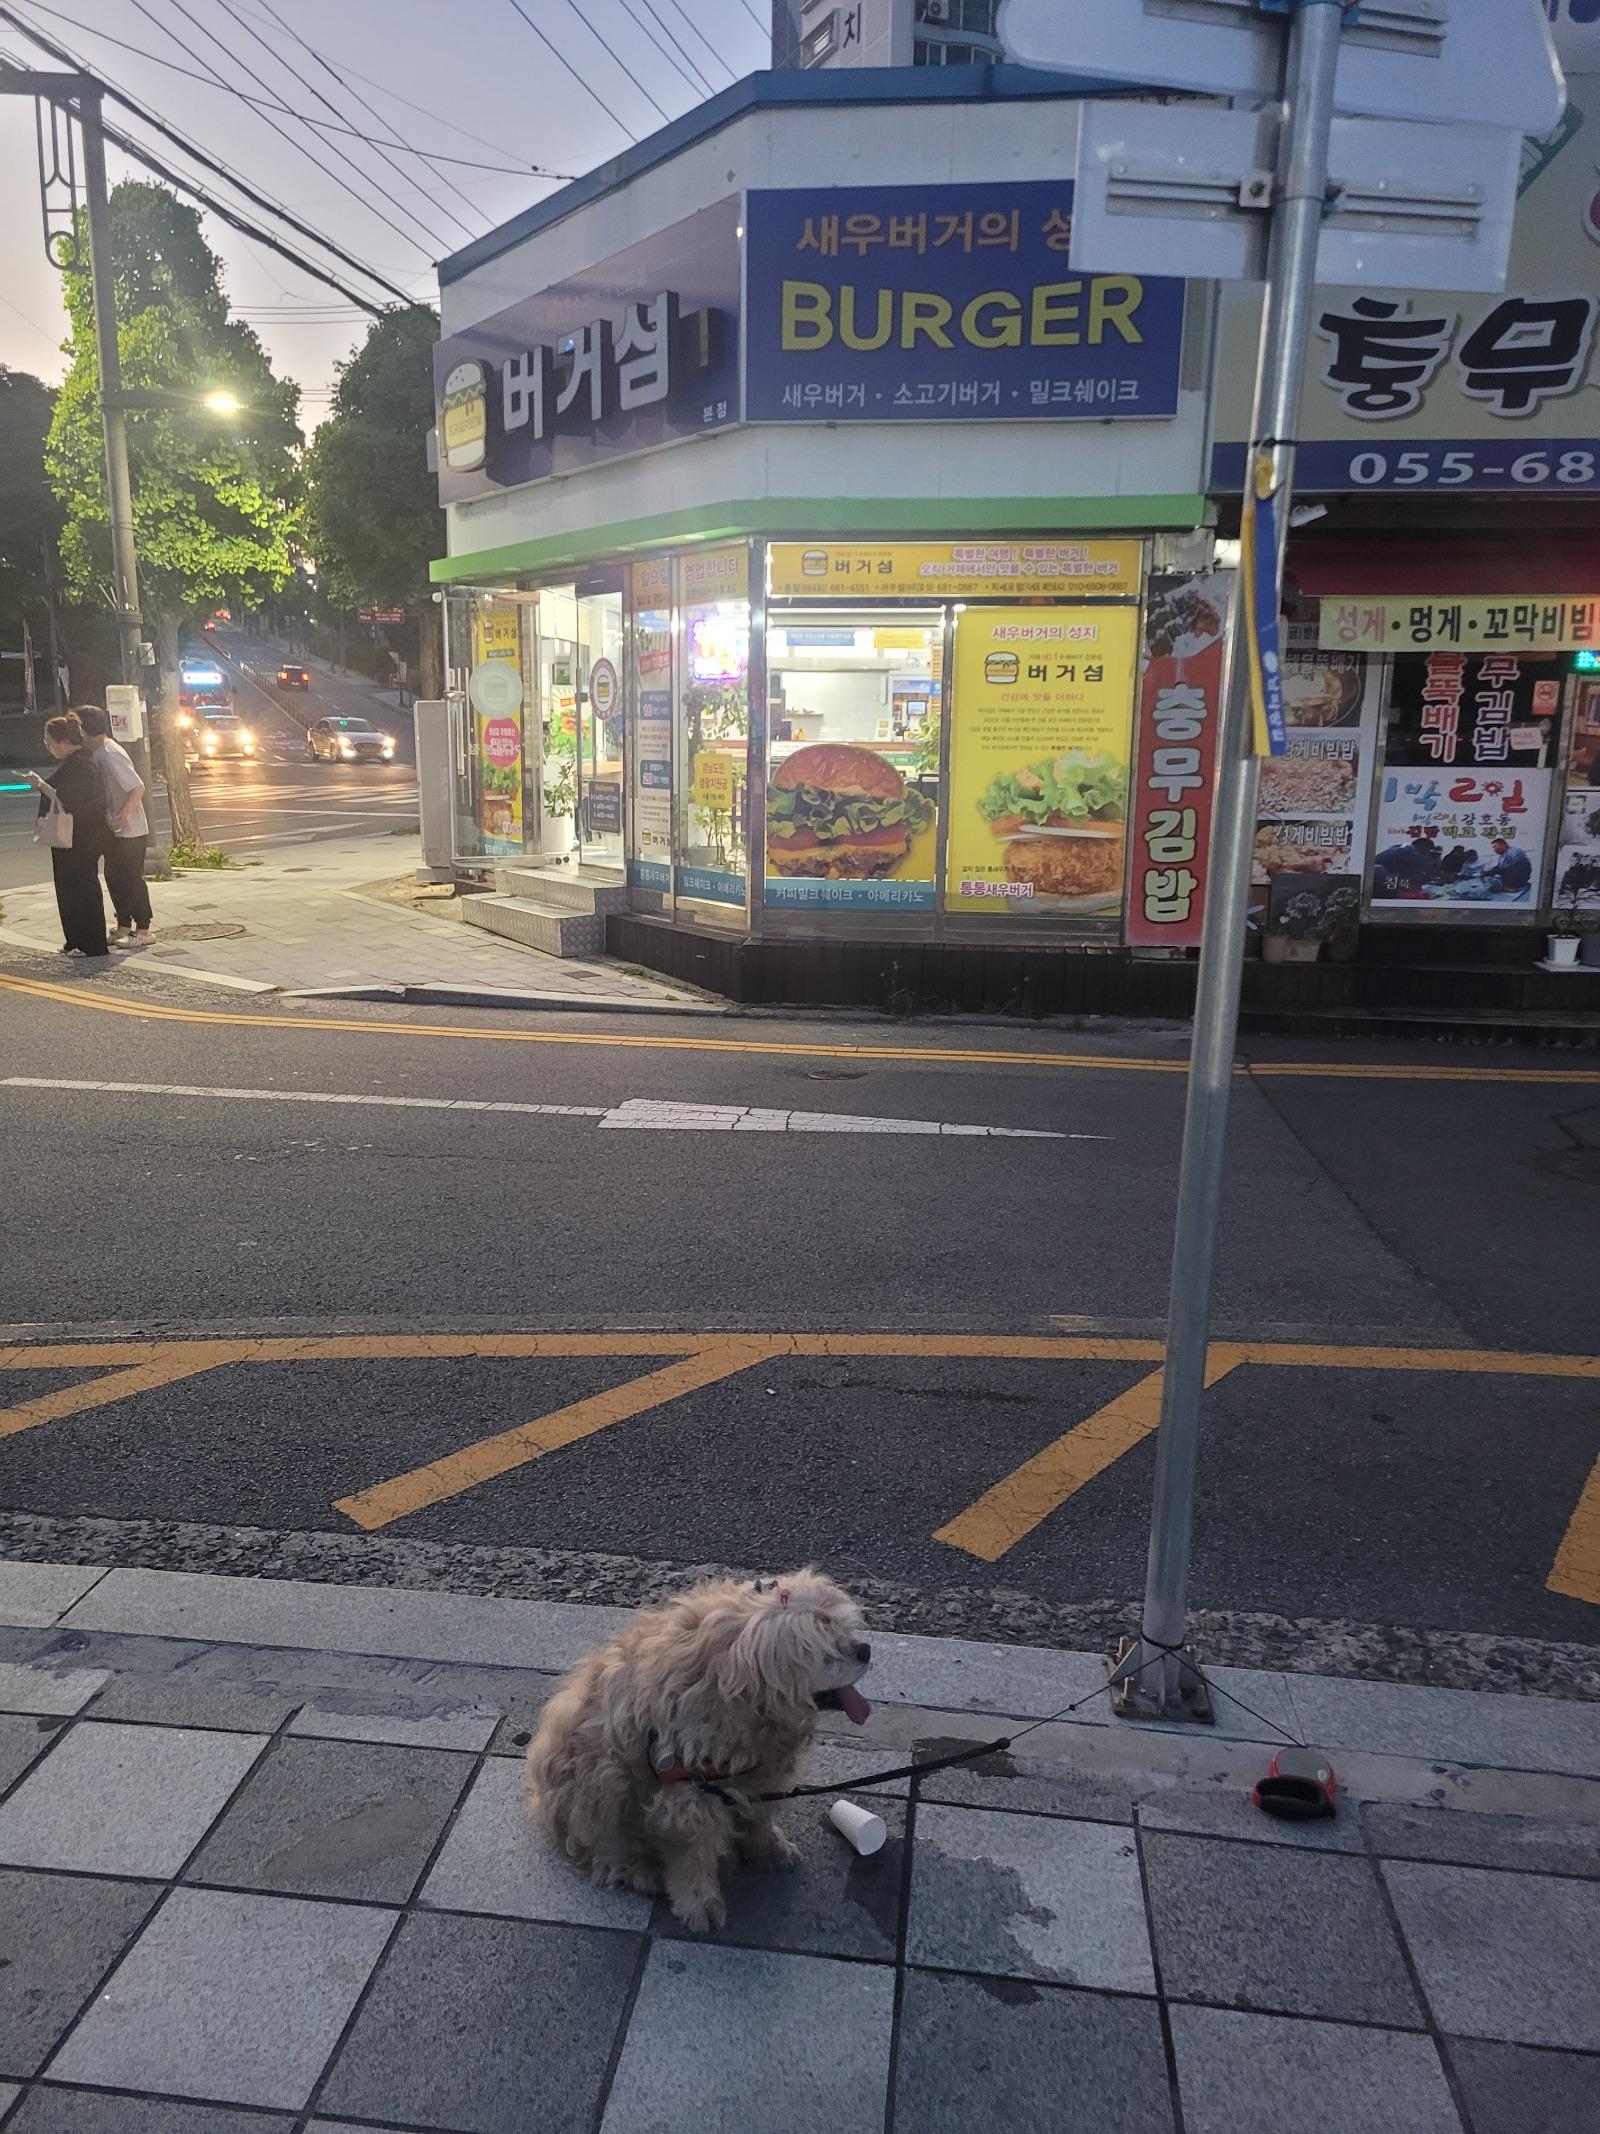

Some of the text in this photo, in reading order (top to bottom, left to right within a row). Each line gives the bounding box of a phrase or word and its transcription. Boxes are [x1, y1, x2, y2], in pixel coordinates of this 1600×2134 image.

[798, 209, 1021, 256] 새우버거의
[781, 277, 1145, 352] BURGER
[503, 290, 669, 441] 버거섬
[782, 376, 1140, 411] 새우버거 소고기버거 밀크쉐이크
[703, 401, 728, 423] 본점
[1348, 451, 1596, 485] 055-68
[834, 559, 894, 575] 버거섬
[992, 625, 1097, 640] 새우버거의 성지
[1337, 605, 1386, 643] 성게
[1408, 605, 1461, 643] 멍게
[1027, 664, 1105, 682] 버거섬
[1144, 682, 1207, 924] 충무김밥
[1461, 813, 1511, 826] 강호동
[867, 888, 926, 903] 아메리카노
[960, 880, 1034, 898] 통통새우버거
